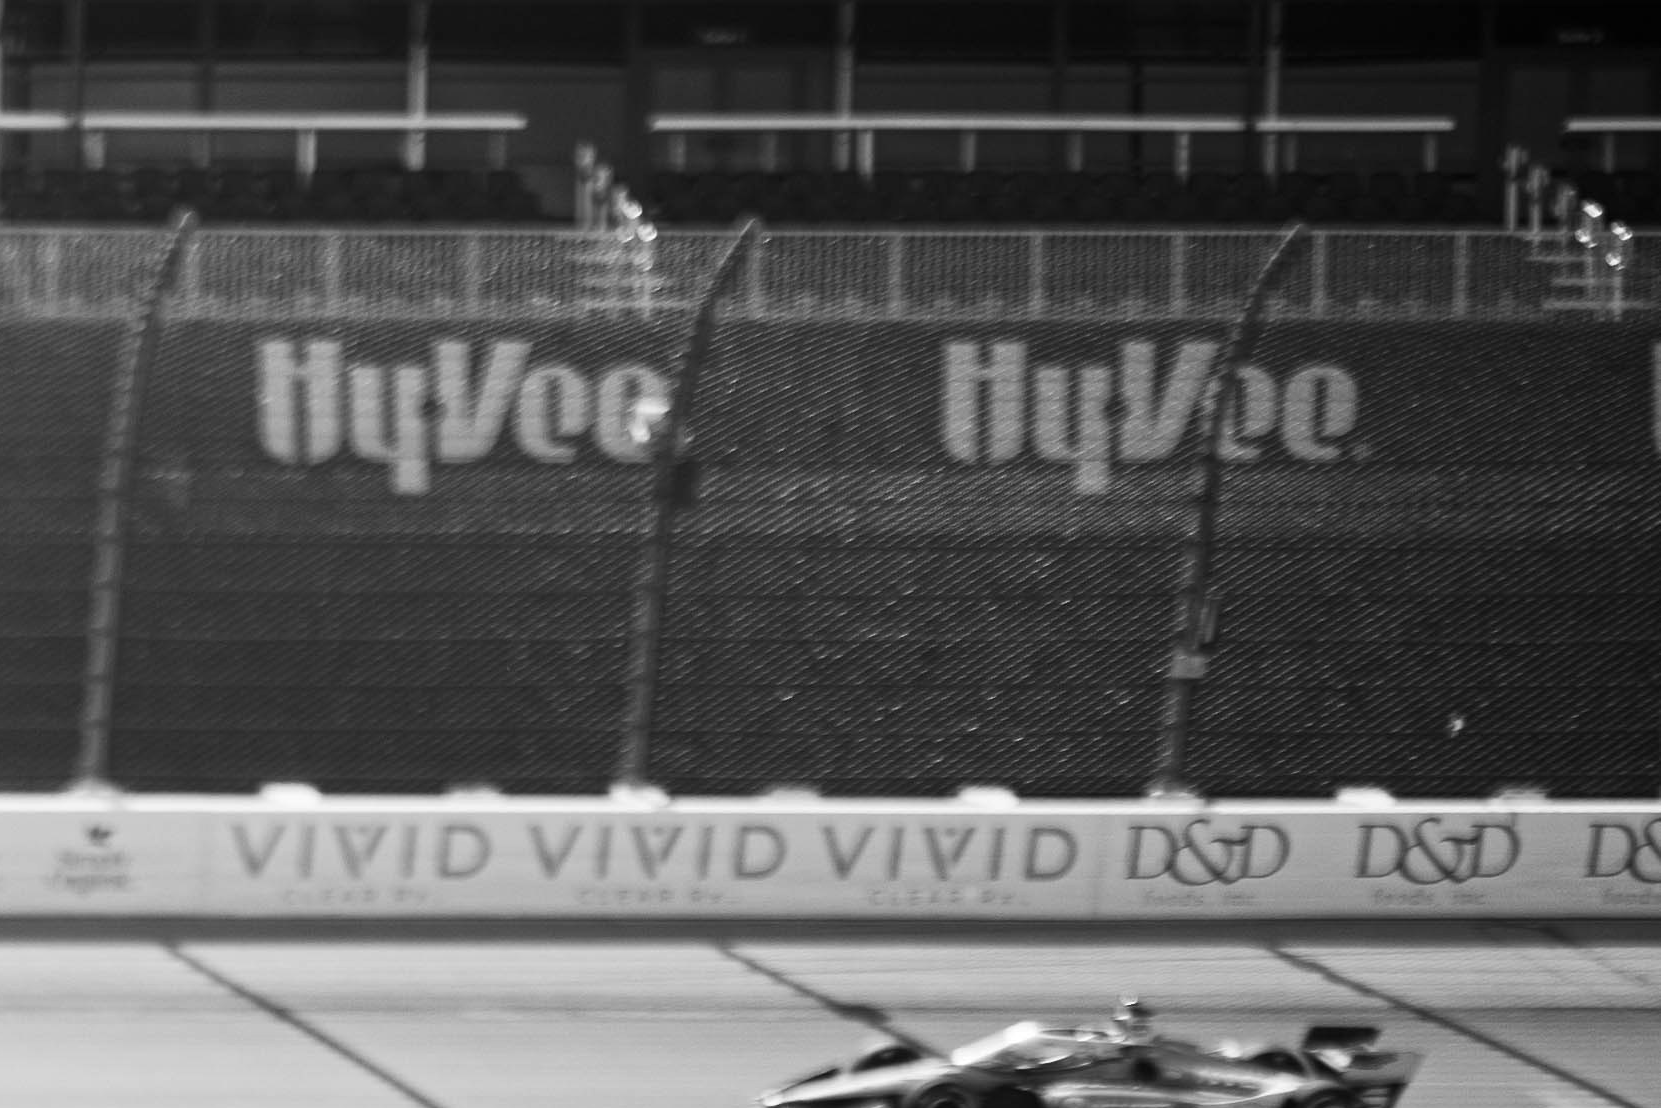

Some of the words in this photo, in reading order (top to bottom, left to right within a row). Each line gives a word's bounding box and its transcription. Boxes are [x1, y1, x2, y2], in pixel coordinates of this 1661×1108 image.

[230, 824, 495, 881] VIVID
[528, 824, 789, 881] VIVID
[819, 824, 1081, 881] VIVID
[1123, 816, 1291, 886] D&D
[1352, 816, 1522, 886] D&D
